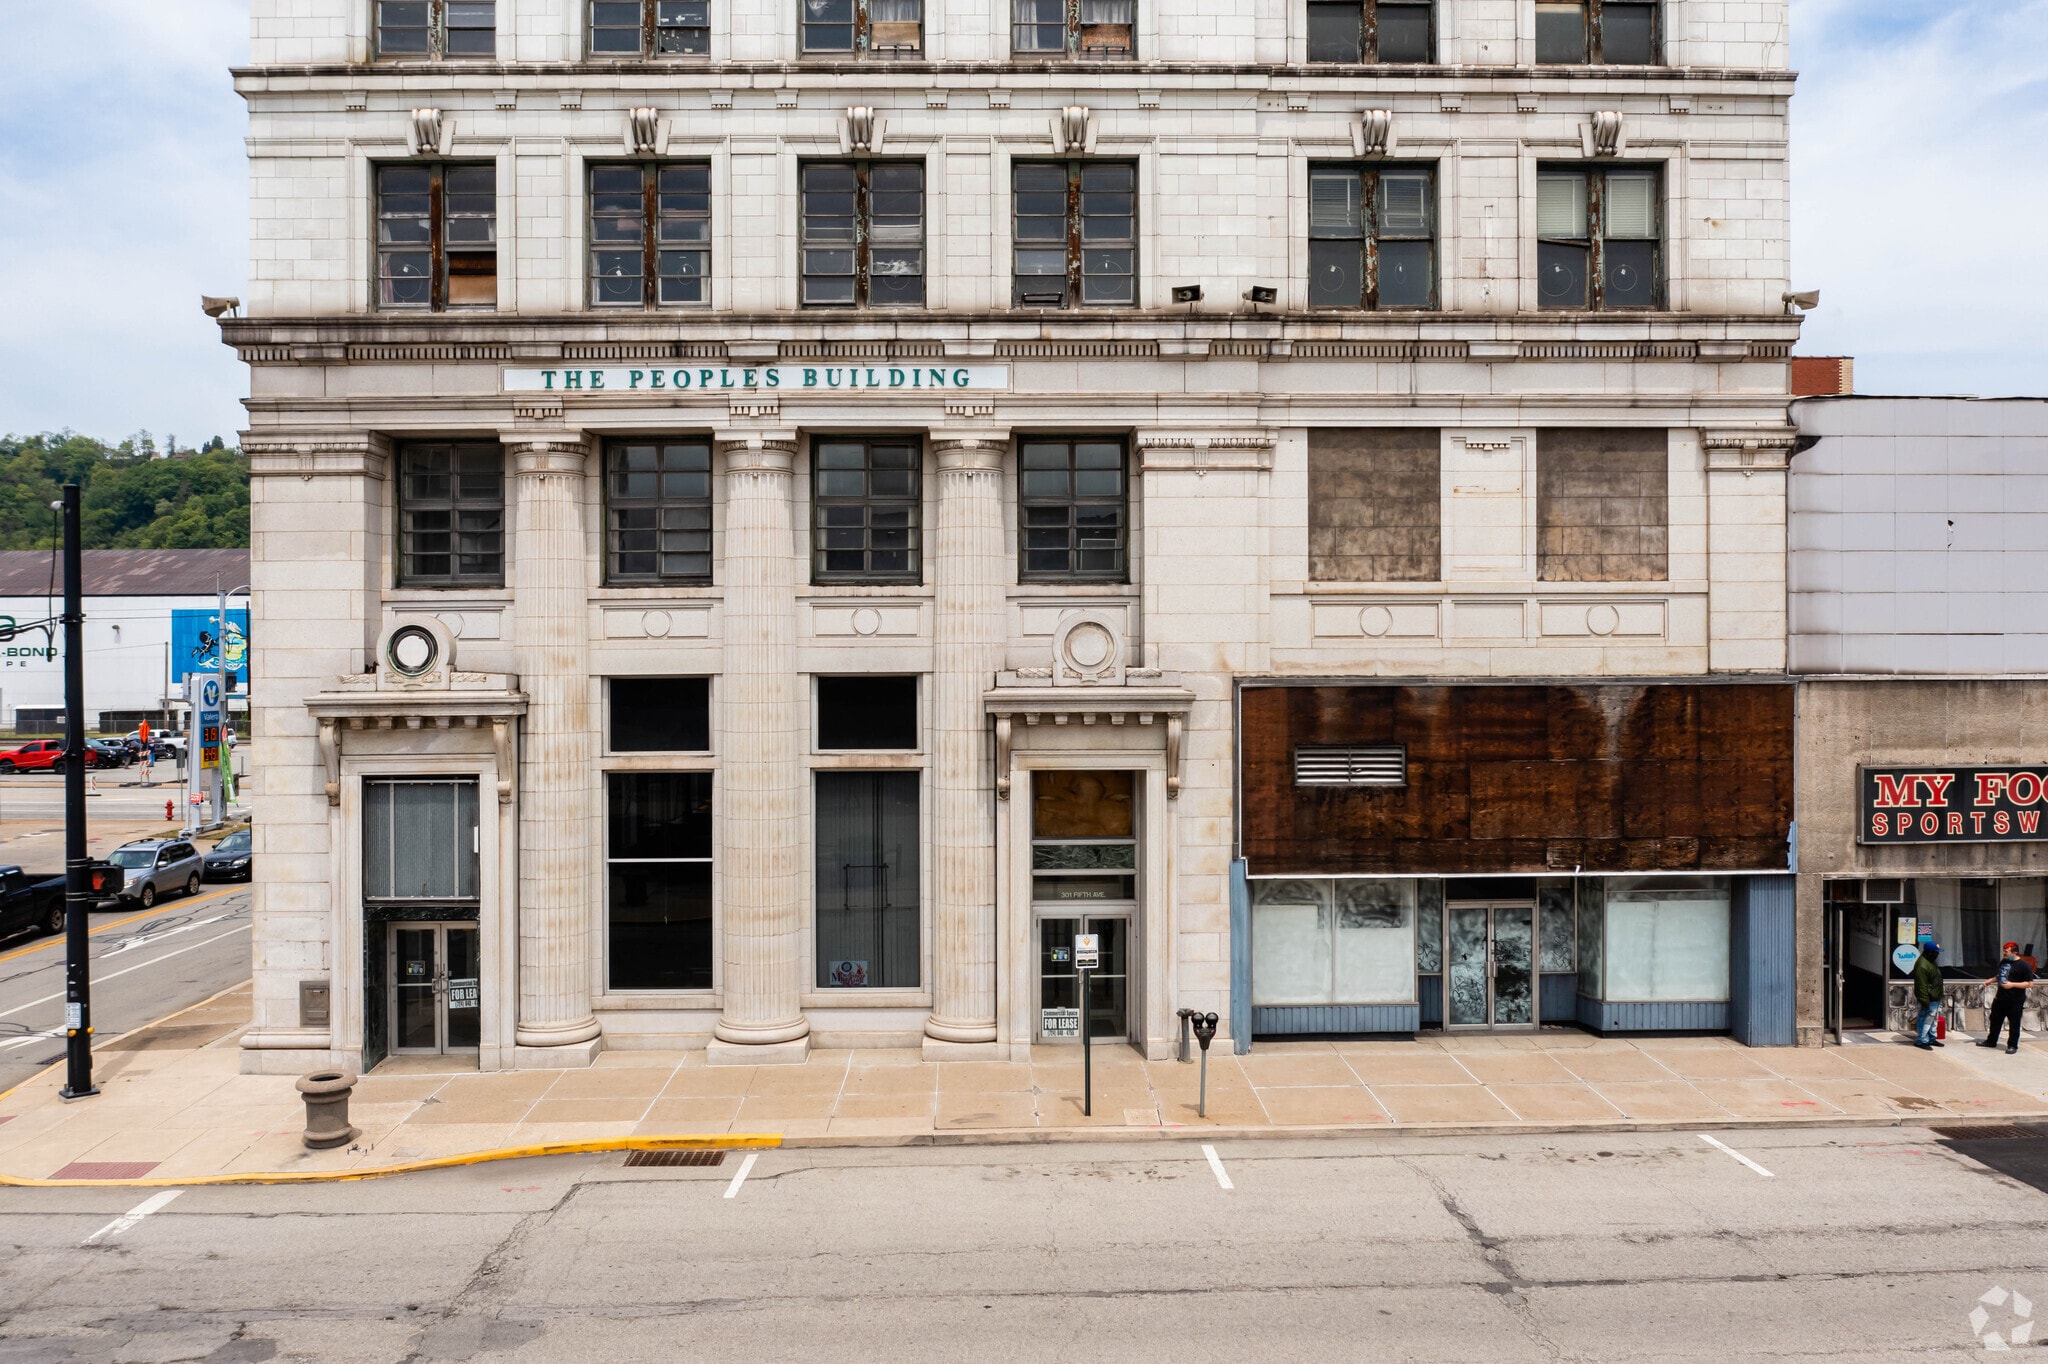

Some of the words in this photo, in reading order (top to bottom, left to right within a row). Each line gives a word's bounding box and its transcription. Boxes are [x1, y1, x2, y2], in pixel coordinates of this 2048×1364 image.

[541, 370, 605, 389] THE
[629, 368, 780, 389] PEOPLES
[802, 368, 970, 388] BUILDING
[203, 712, 220, 721] Valero
[1874, 773, 1955, 808] MY
[1974, 772, 2048, 807] FO
[1872, 810, 2040, 837] SPORTSW
[451, 989, 465, 1000] FOR
[1044, 1018, 1058, 1030] FOR
[1058, 1018, 1078, 1029] LEASE
